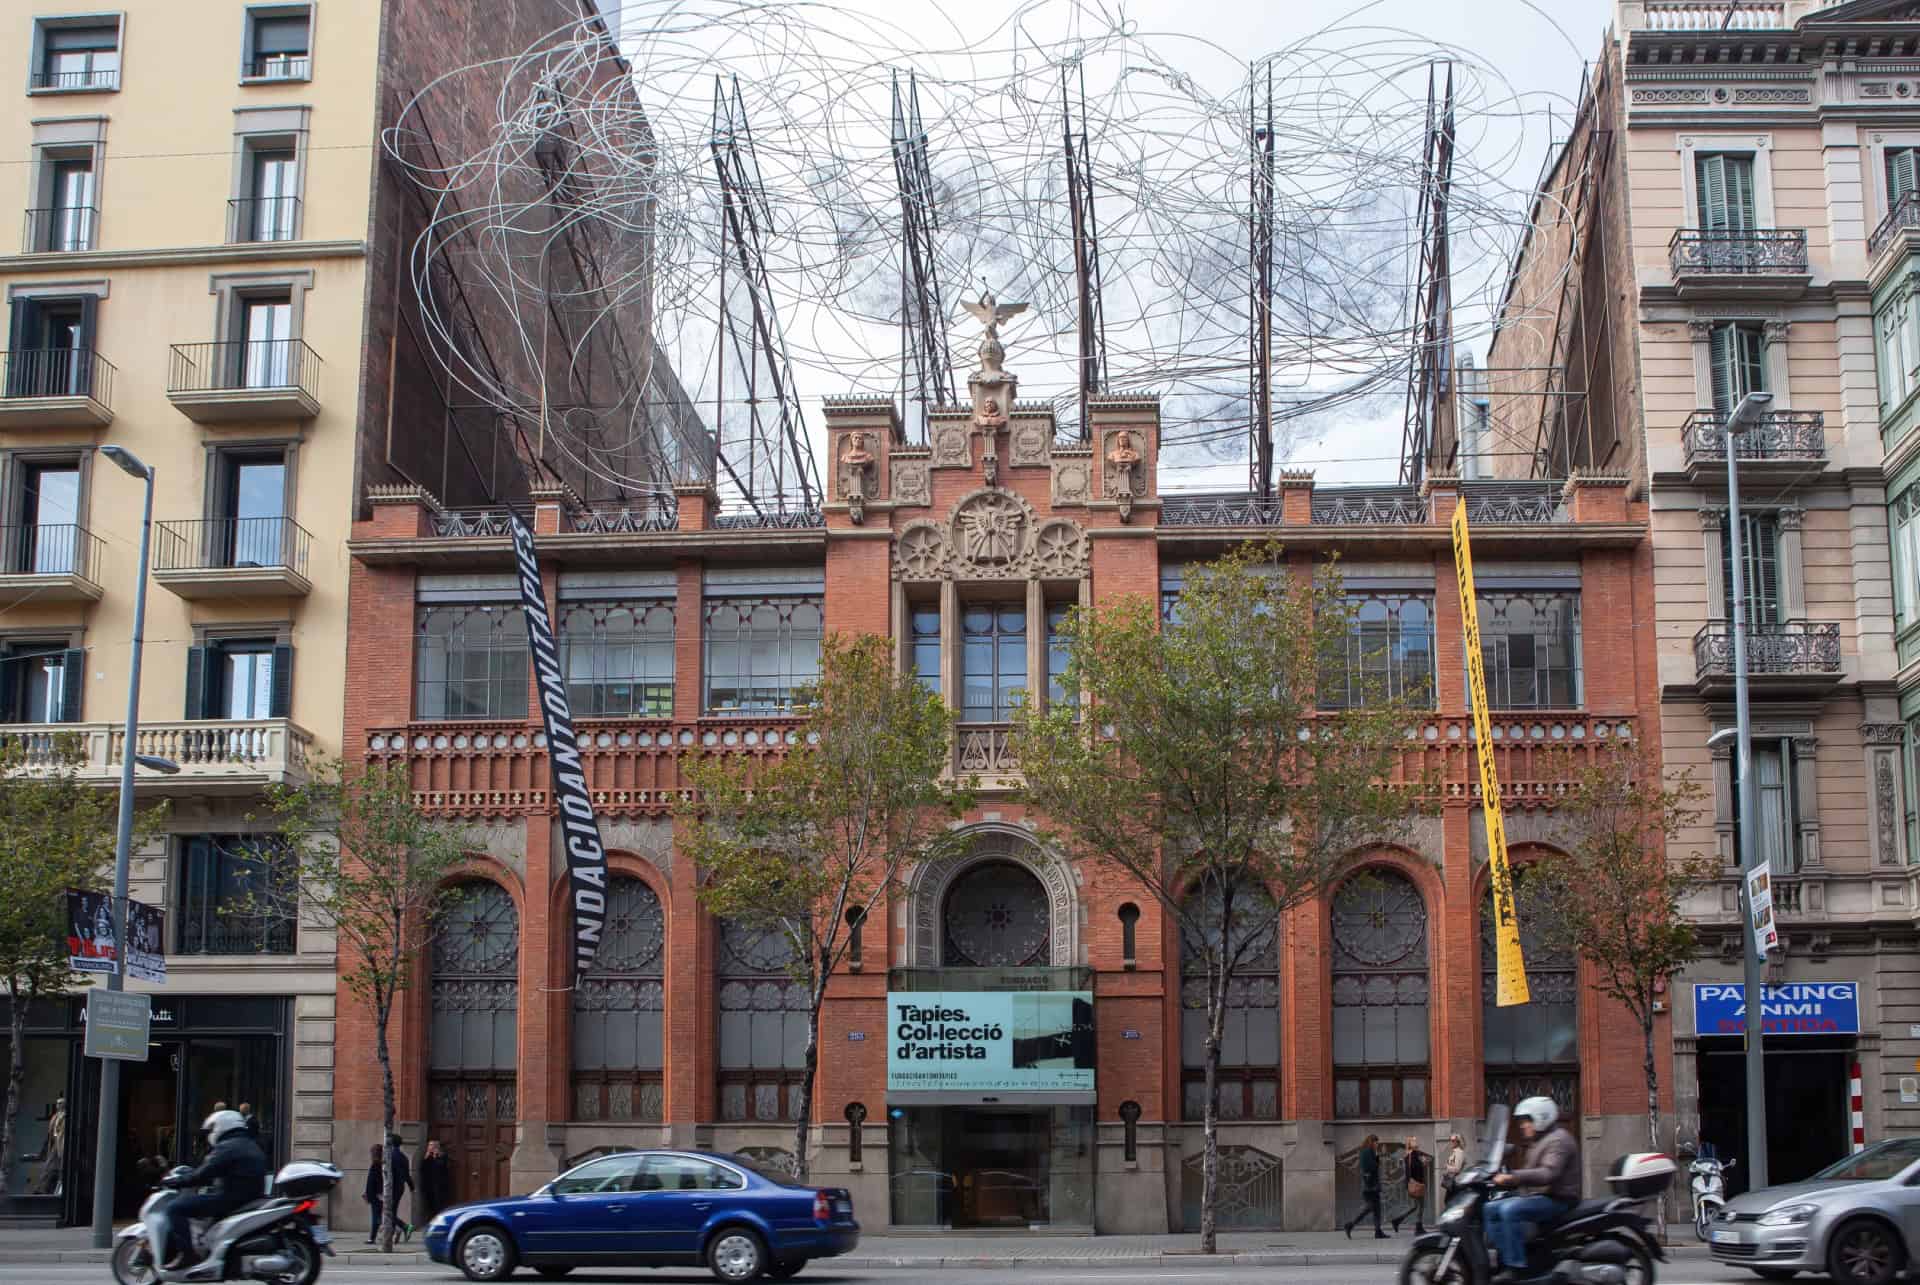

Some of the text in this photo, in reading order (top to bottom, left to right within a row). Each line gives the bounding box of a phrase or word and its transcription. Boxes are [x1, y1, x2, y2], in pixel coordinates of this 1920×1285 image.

[1701, 986, 1853, 1001] PAKING
[897, 1004, 970, 1025] Tàpies.
[897, 1023, 1003, 1041] Col·lecció
